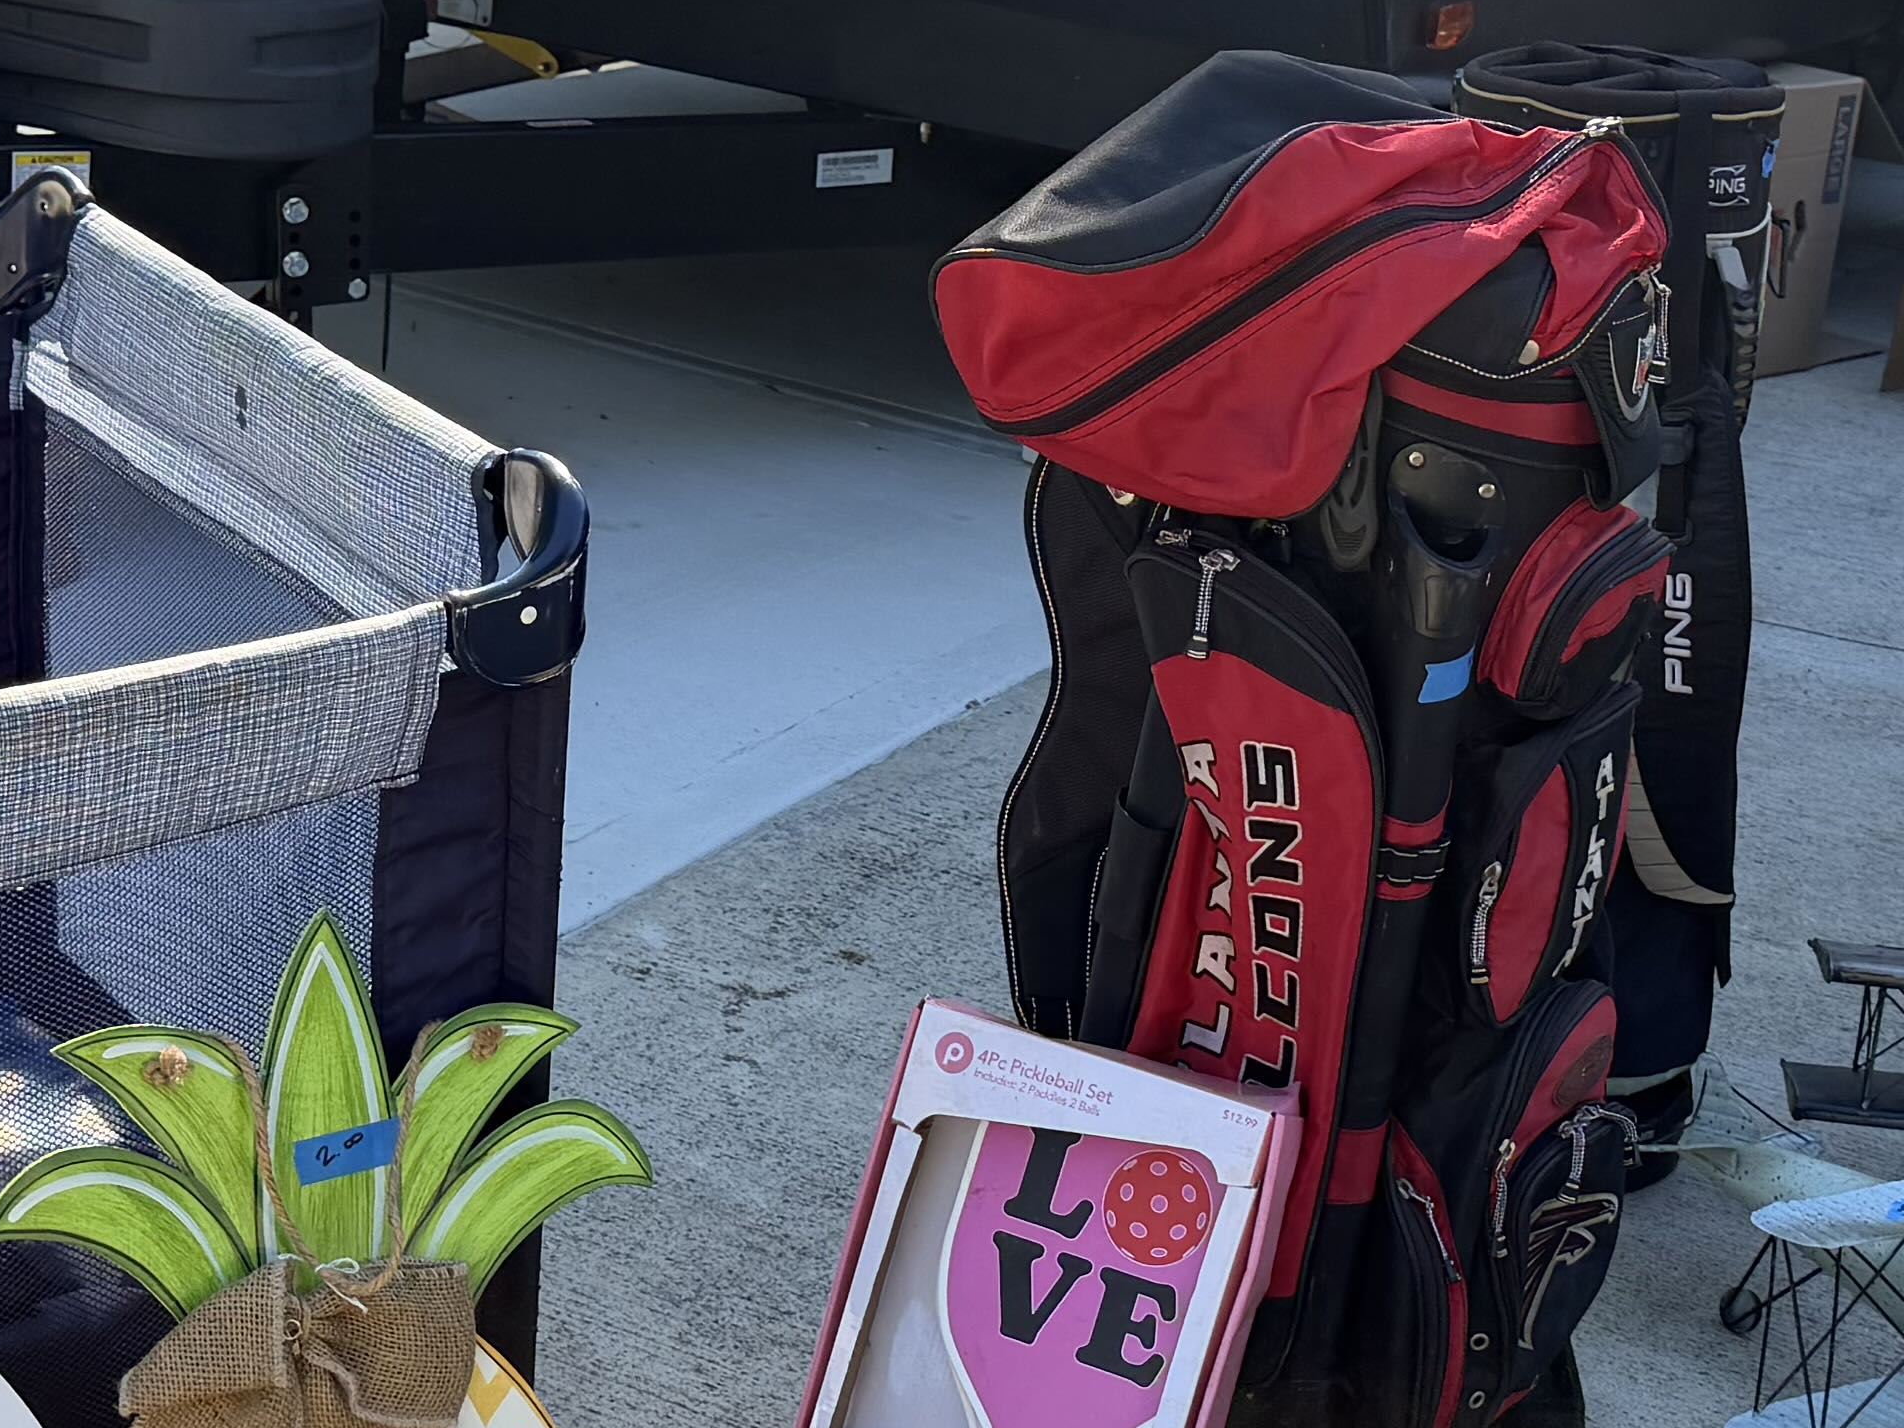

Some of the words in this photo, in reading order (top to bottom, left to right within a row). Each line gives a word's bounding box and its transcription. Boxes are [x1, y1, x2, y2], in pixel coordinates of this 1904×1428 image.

[1663, 573, 1693, 695] PING
[1238, 740, 1303, 1092] LCONS
[1009, 1058, 1084, 1096] Pickleball
[1086, 1082, 1115, 1105] Set
